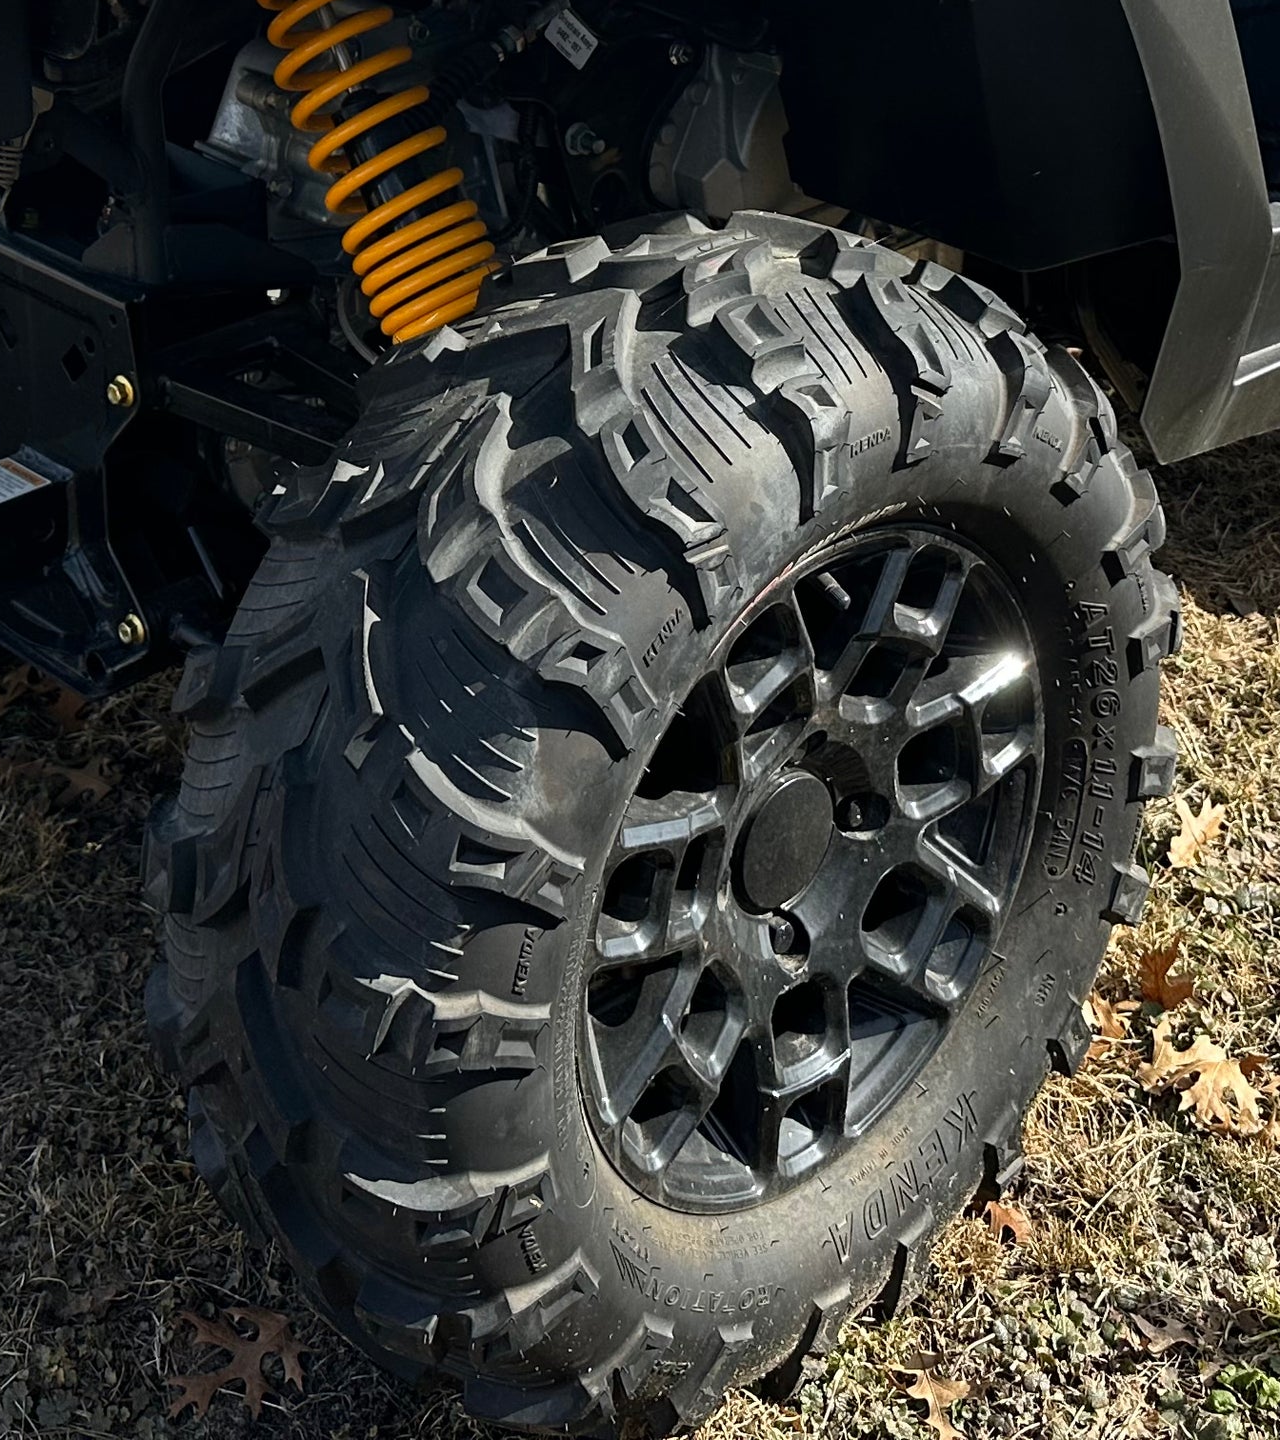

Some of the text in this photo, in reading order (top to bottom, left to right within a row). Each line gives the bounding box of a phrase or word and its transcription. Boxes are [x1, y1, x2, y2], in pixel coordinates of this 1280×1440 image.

[850, 427, 892, 459] KENDA
[641, 607, 683, 669] KENDA
[511, 927, 545, 996] KENDA
[822, 1090, 978, 1266] KENDA
[644, 1274, 771, 1315] ROTATION
